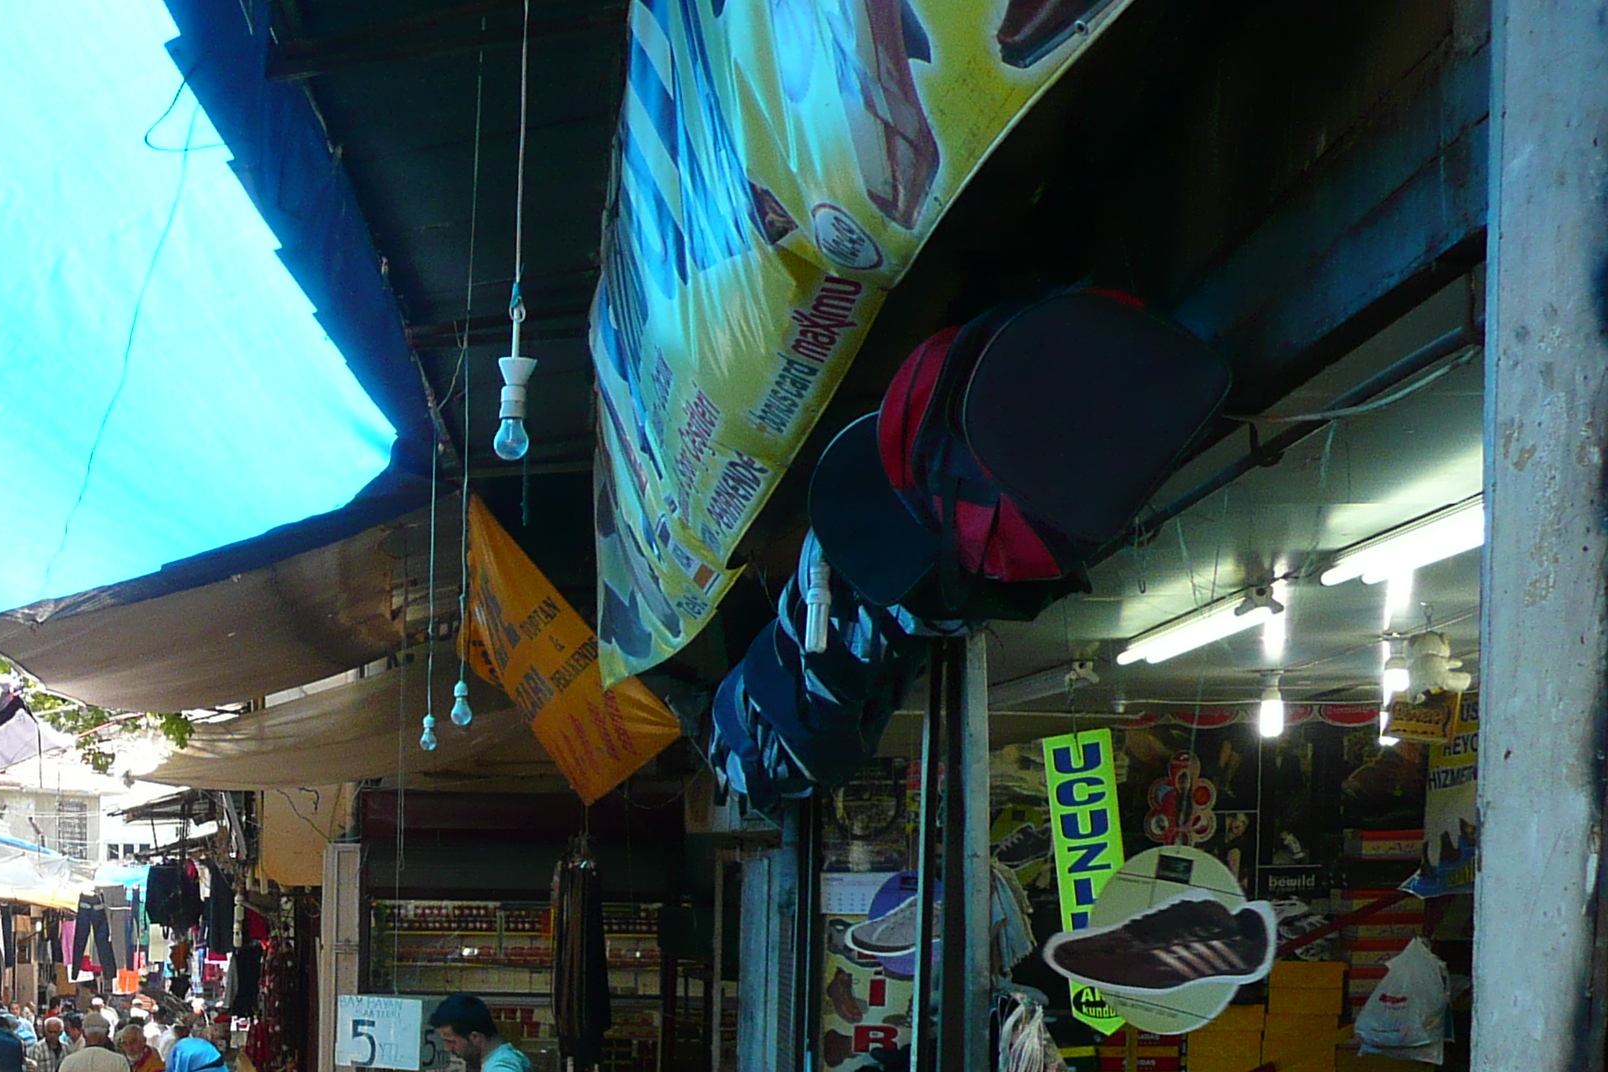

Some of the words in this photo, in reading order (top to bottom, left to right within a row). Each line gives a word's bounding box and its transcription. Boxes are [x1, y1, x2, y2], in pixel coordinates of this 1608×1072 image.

[774, 351, 820, 404] card
[519, 596, 562, 641] TOPTAN
[1268, 873, 1316, 890] bewild
[351, 1019, 377, 1067] 5
[422, 1030, 437, 1067] 5
